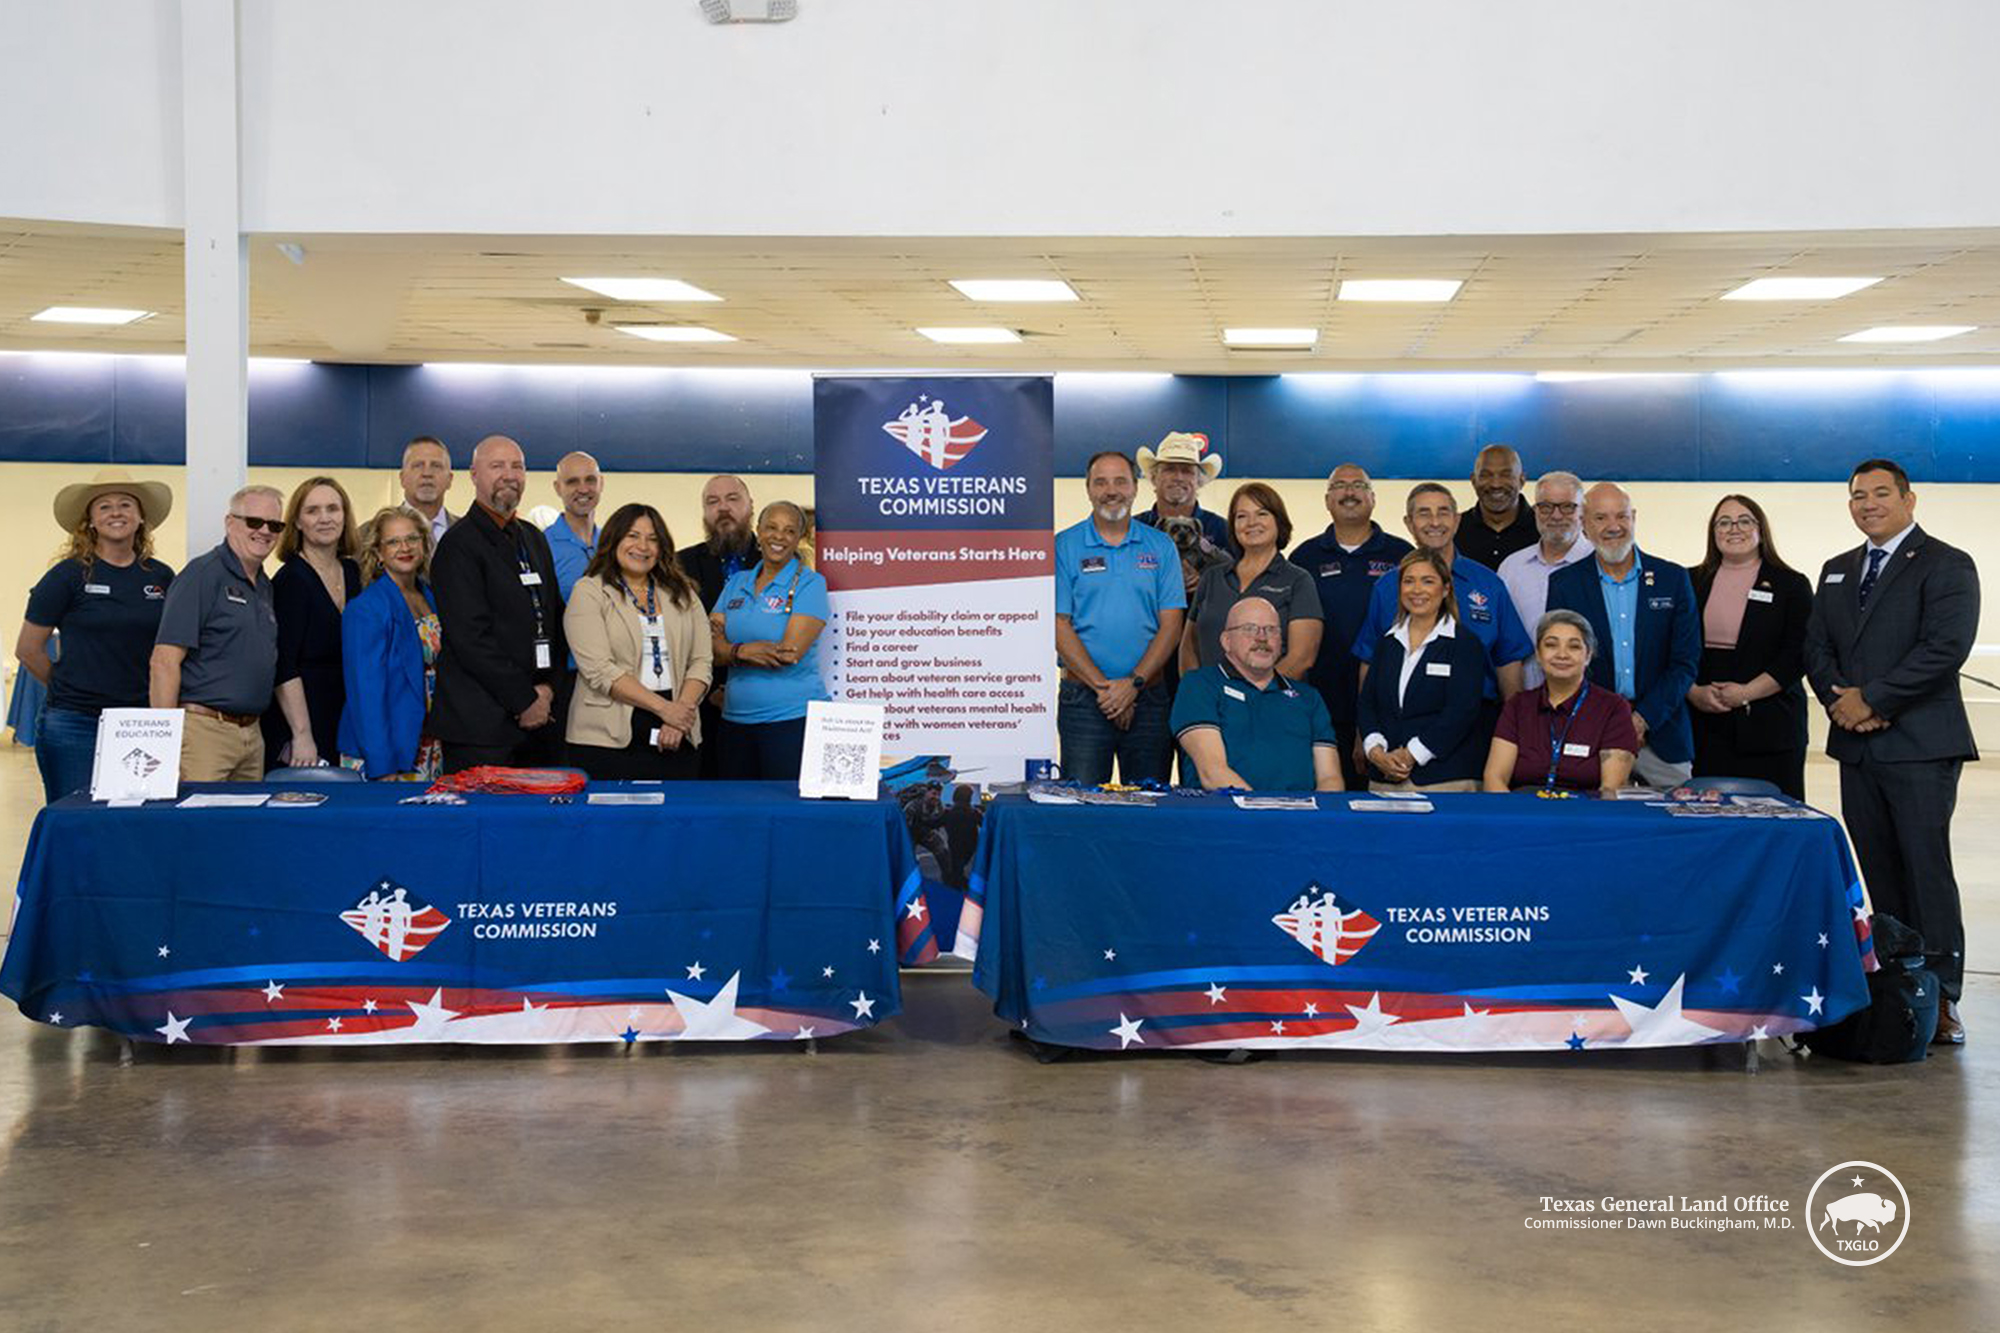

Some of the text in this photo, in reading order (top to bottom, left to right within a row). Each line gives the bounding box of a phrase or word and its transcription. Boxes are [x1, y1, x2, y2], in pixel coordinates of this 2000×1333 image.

[858, 477, 1027, 495] TEXAS VETERANS
[879, 498, 1005, 515] COMMISSION
[823, 547, 1046, 565] Helping Veterans Starts Here
[846, 611, 865, 621] File
[867, 613, 894, 623] your
[897, 610, 948, 623] disability
[951, 610, 980, 620] claim
[998, 610, 1039, 623] appeal
[846, 625, 1002, 639] Use your education benefits
[846, 642, 919, 652] Find a career
[846, 656, 982, 670] Start and grow business
[846, 672, 1042, 685] Learn about veteran service grants
[846, 688, 1024, 700] Get help with health care access
[918, 705, 966, 713] veterans
[969, 704, 1008, 713] mental
[1011, 703, 1046, 713] health
[119, 720, 171, 728] VETERANS
[894, 719, 919, 729] with
[922, 720, 965, 729] women
[115, 730, 172, 738] EDUCATION
[457, 902, 618, 919] TEXAS VETERANS
[1386, 906, 1550, 923] TEXAS VETERANS
[473, 922, 598, 939] COMMISSION
[1405, 927, 1532, 943] COMMISSION
